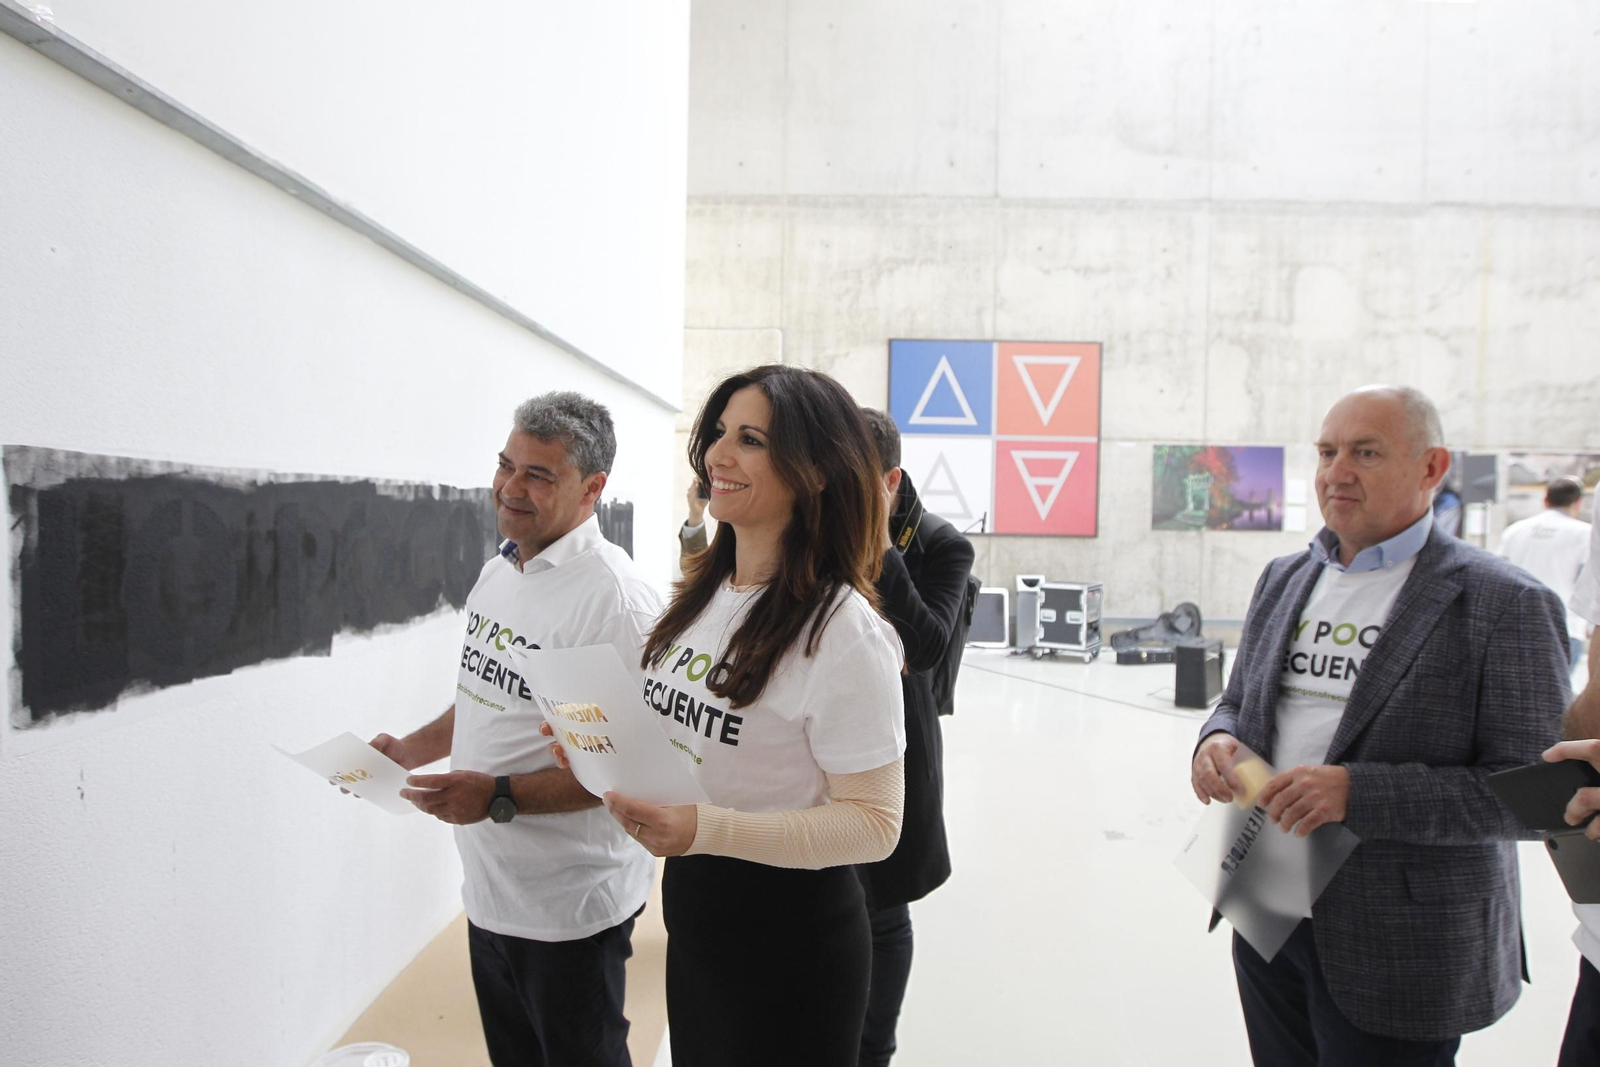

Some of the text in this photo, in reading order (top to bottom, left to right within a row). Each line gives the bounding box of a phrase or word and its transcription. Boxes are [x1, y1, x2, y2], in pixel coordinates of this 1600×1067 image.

[898, 526, 913, 547] Nikon
[486, 622, 541, 651] POC
[1314, 621, 1381, 649] POC
[461, 643, 532, 701] ECUENTE
[1282, 650, 1360, 680] ECUEN
[643, 677, 743, 746] ECUENTE
